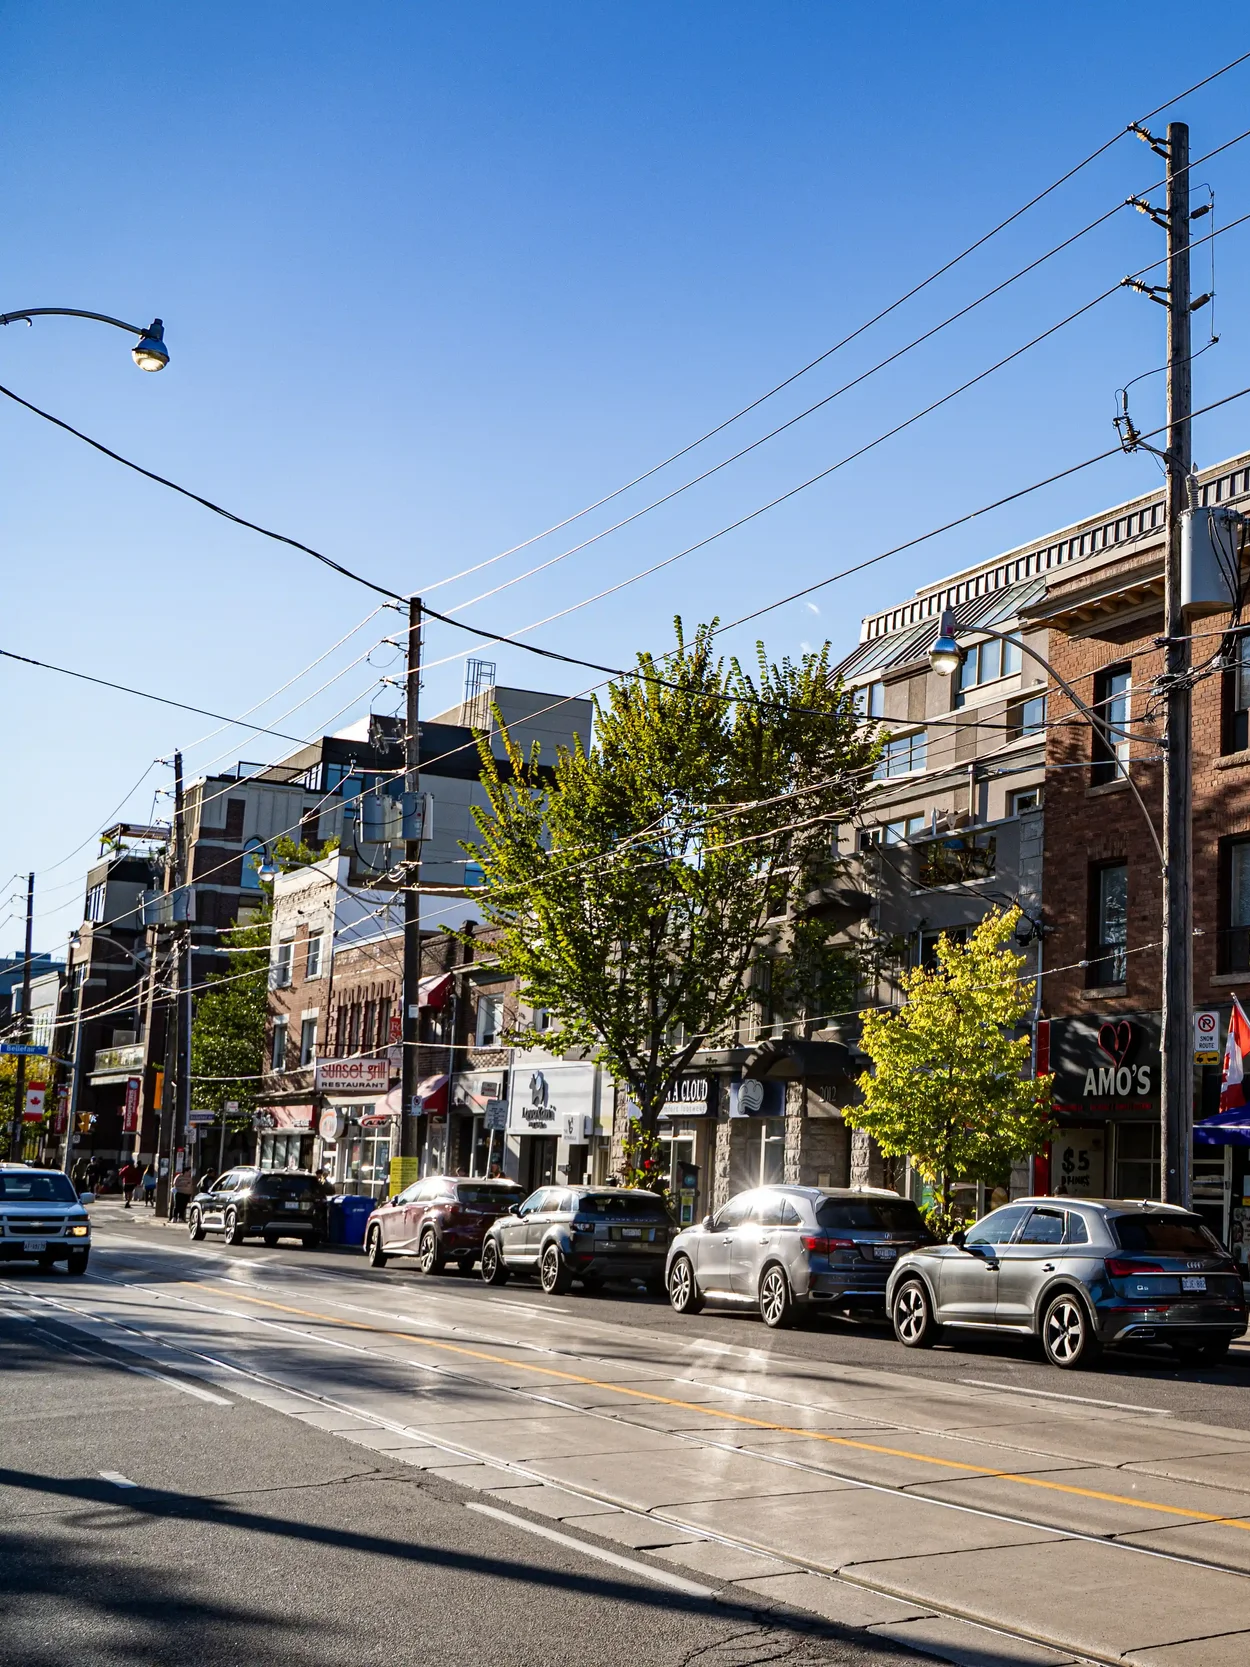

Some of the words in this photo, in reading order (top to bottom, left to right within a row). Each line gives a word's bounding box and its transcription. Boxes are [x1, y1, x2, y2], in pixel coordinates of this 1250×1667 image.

[6, 1044, 36, 1052] Bellefair
[321, 1062, 363, 1079] sunset
[368, 1062, 386, 1082] grill
[1083, 1064, 1151, 1096] AMO'S
[681, 1079, 708, 1102] CLOUD
[1062, 1176, 1090, 1186] DRINKS
